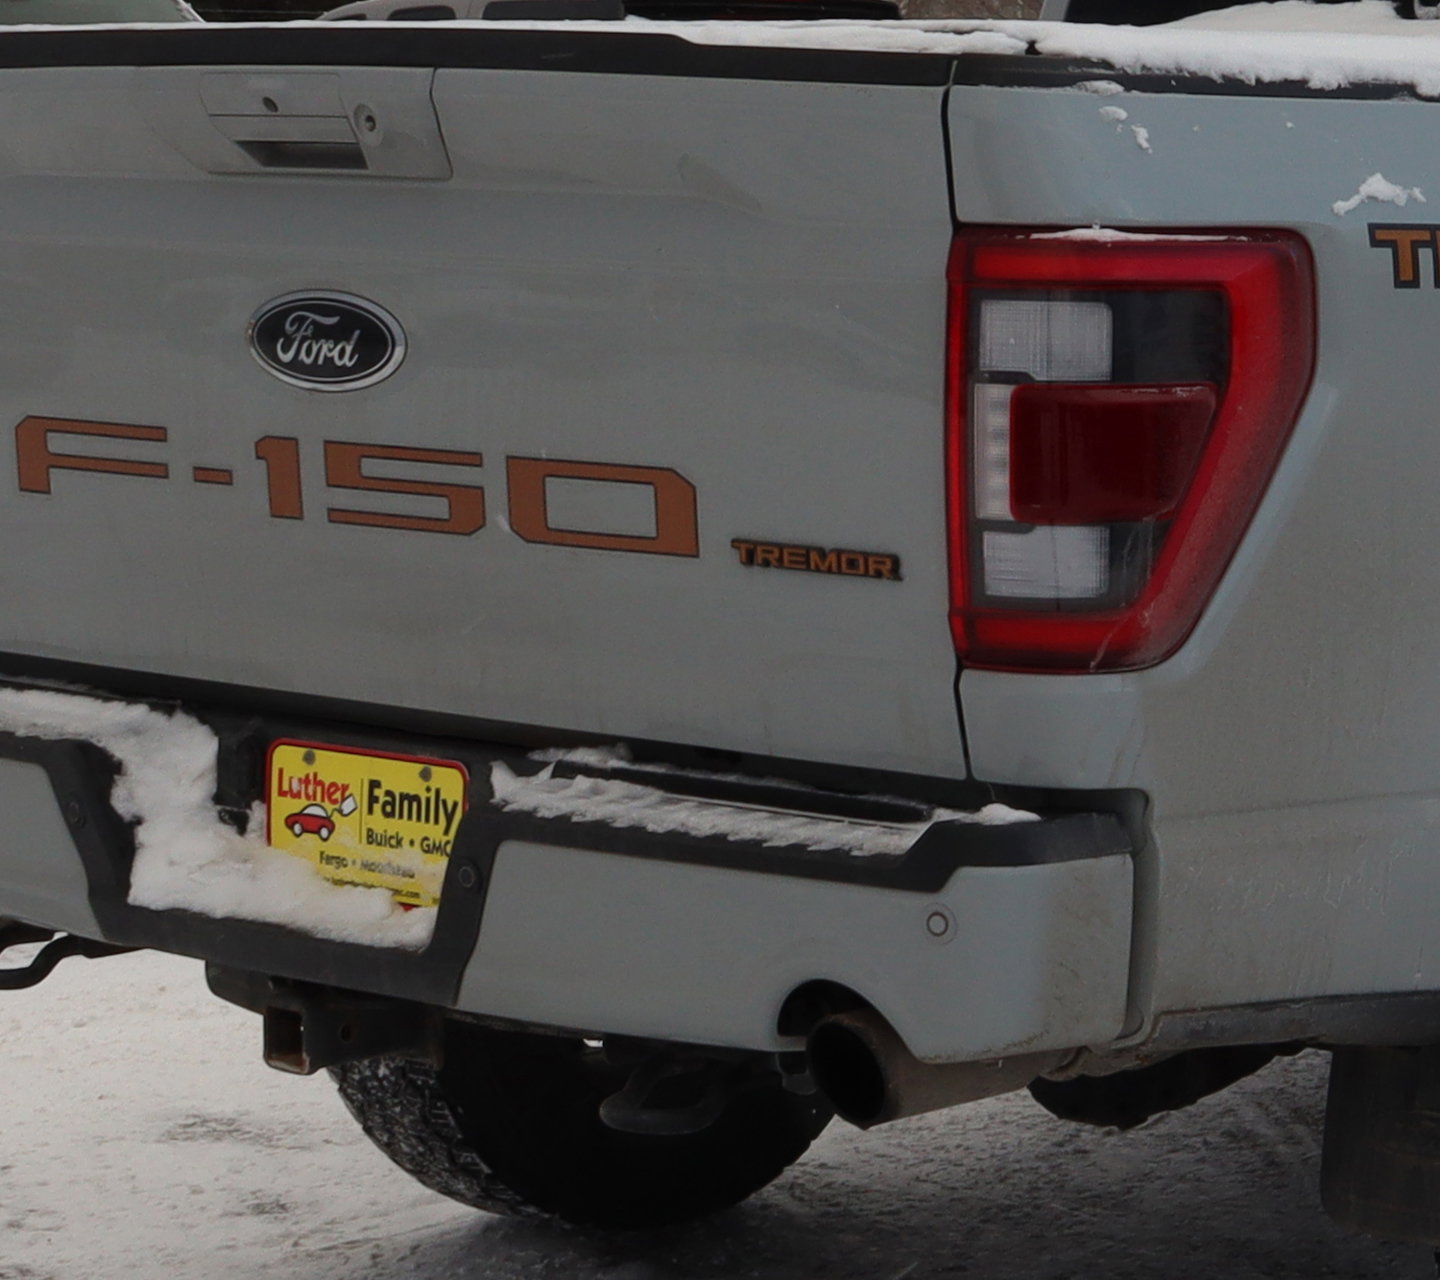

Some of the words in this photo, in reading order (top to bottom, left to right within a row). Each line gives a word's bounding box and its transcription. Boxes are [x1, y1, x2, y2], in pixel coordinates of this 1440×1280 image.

[276, 310, 361, 368] Ford
[14, 413, 700, 558] F-150
[731, 538, 904, 582] TREMOR
[277, 767, 350, 806] Luther
[367, 778, 459, 837] Family
[319, 850, 349, 870] Fargo
[366, 827, 404, 849] Buick
[420, 836, 451, 858] GMC
